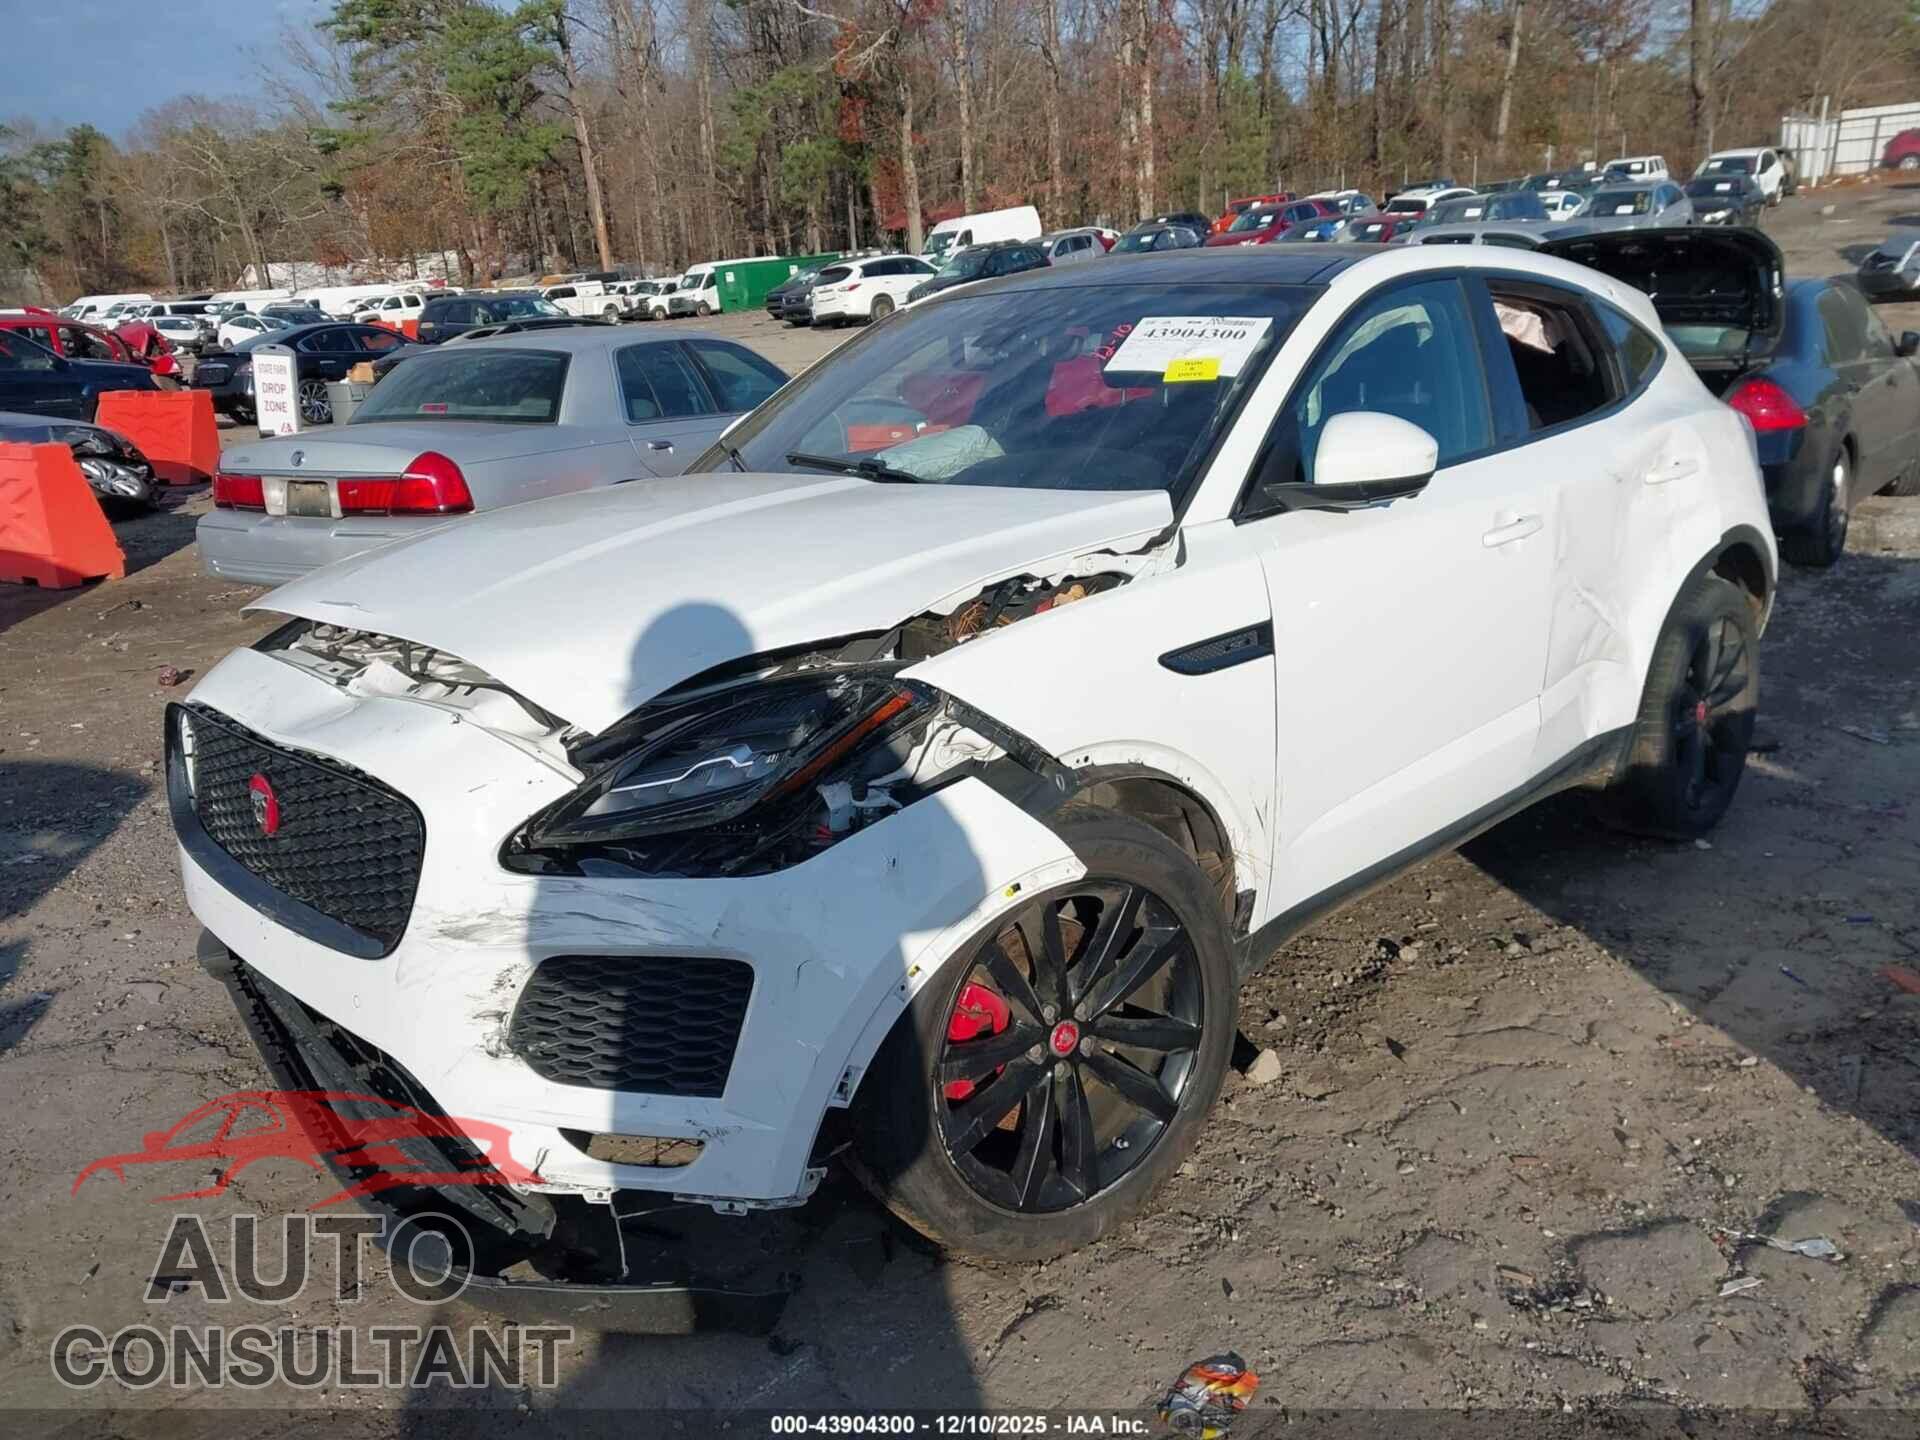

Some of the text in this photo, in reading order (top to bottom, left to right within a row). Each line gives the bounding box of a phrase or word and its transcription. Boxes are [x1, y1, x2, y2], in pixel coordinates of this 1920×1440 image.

[1145, 327, 1247, 340] 43904300
[262, 382, 287, 394] DROP
[264, 400, 288, 414] ZONE
